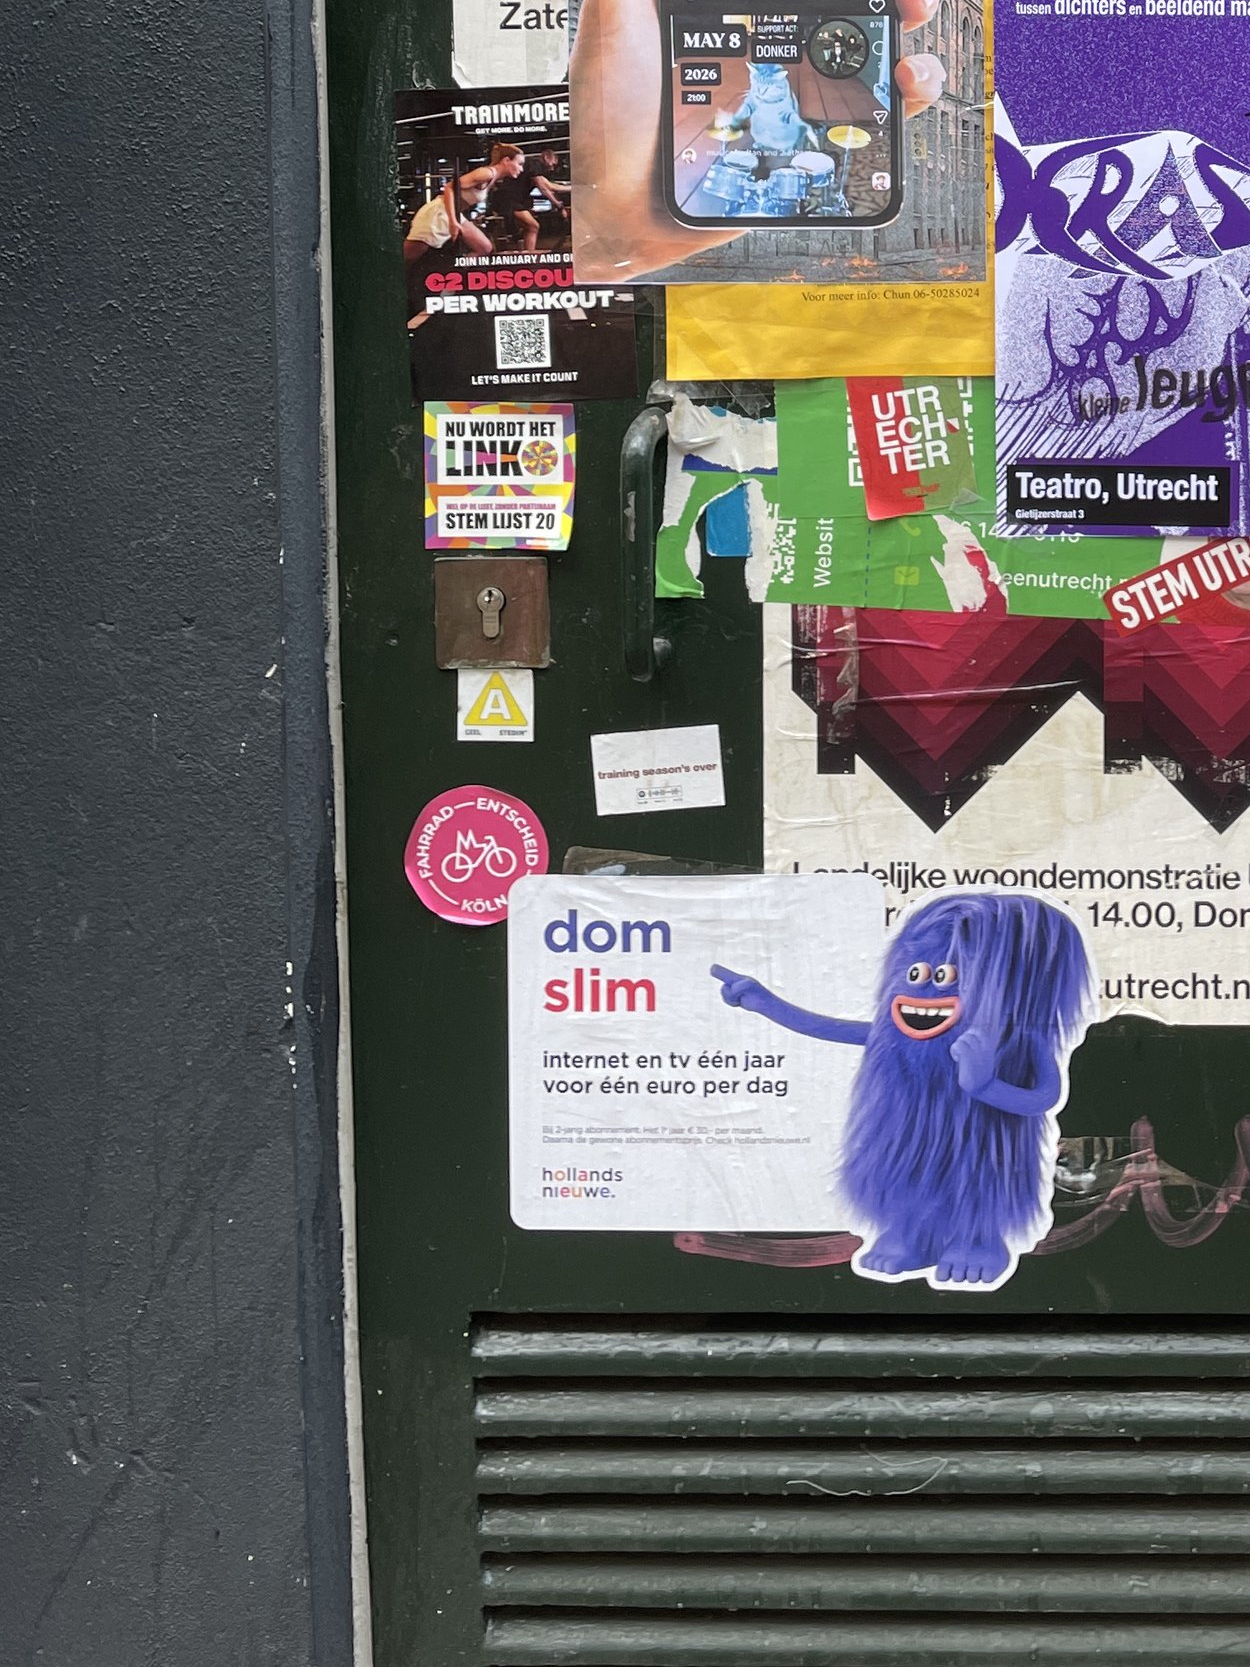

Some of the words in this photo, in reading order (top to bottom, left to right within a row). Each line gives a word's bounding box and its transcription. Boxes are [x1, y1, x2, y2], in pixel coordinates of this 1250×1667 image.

[1016, 0, 1052, 17] tussen
[1129, 1, 1143, 16] en
[683, 32, 724, 48] MAY
[728, 32, 741, 47] 8
[756, 44, 798, 58] DONKER
[684, 69, 717, 81] 2026
[451, 102, 570, 125] TRAINMORE
[425, 296, 478, 314] PER
[484, 290, 615, 312] WORKOUT
[802, 290, 827, 303] Voor
[829, 291, 854, 302] meer
[856, 290, 881, 302] info:
[882, 288, 911, 300] Chun
[913, 287, 981, 300] 06-50285024
[1016, 471, 1110, 505] Teatro,
[1115, 472, 1219, 503] Utrecht
[1110, 565, 1199, 629] STEM
[480, 688, 512, 719] A
[598, 770, 640, 780] training
[642, 765, 690, 776] season's
[693, 764, 717, 772] over
[416, 806, 454, 878] FAHRRAD
[476, 798, 539, 866] ENTSCHEID
[953, 861, 1241, 891] woondemonstratie
[461, 894, 508, 913] KÖLN
[1088, 902, 1184, 932] 14.00,
[543, 908, 672, 955] dom
[543, 966, 657, 1013] slim
[542, 1050, 631, 1070] internet
[635, 1055, 664, 1070] en
[668, 1054, 692, 1070] tv
[698, 1051, 738, 1070] één
[741, 1051, 786, 1074] jaar
[542, 1079, 595, 1095] voor
[599, 1076, 640, 1095] één
[645, 1079, 698, 1095] euro
[703, 1079, 741, 1100] per
[746, 1076, 789, 1100] dag
[542, 1168, 623, 1182] hollands
[542, 1186, 616, 1198] nieuwe.
